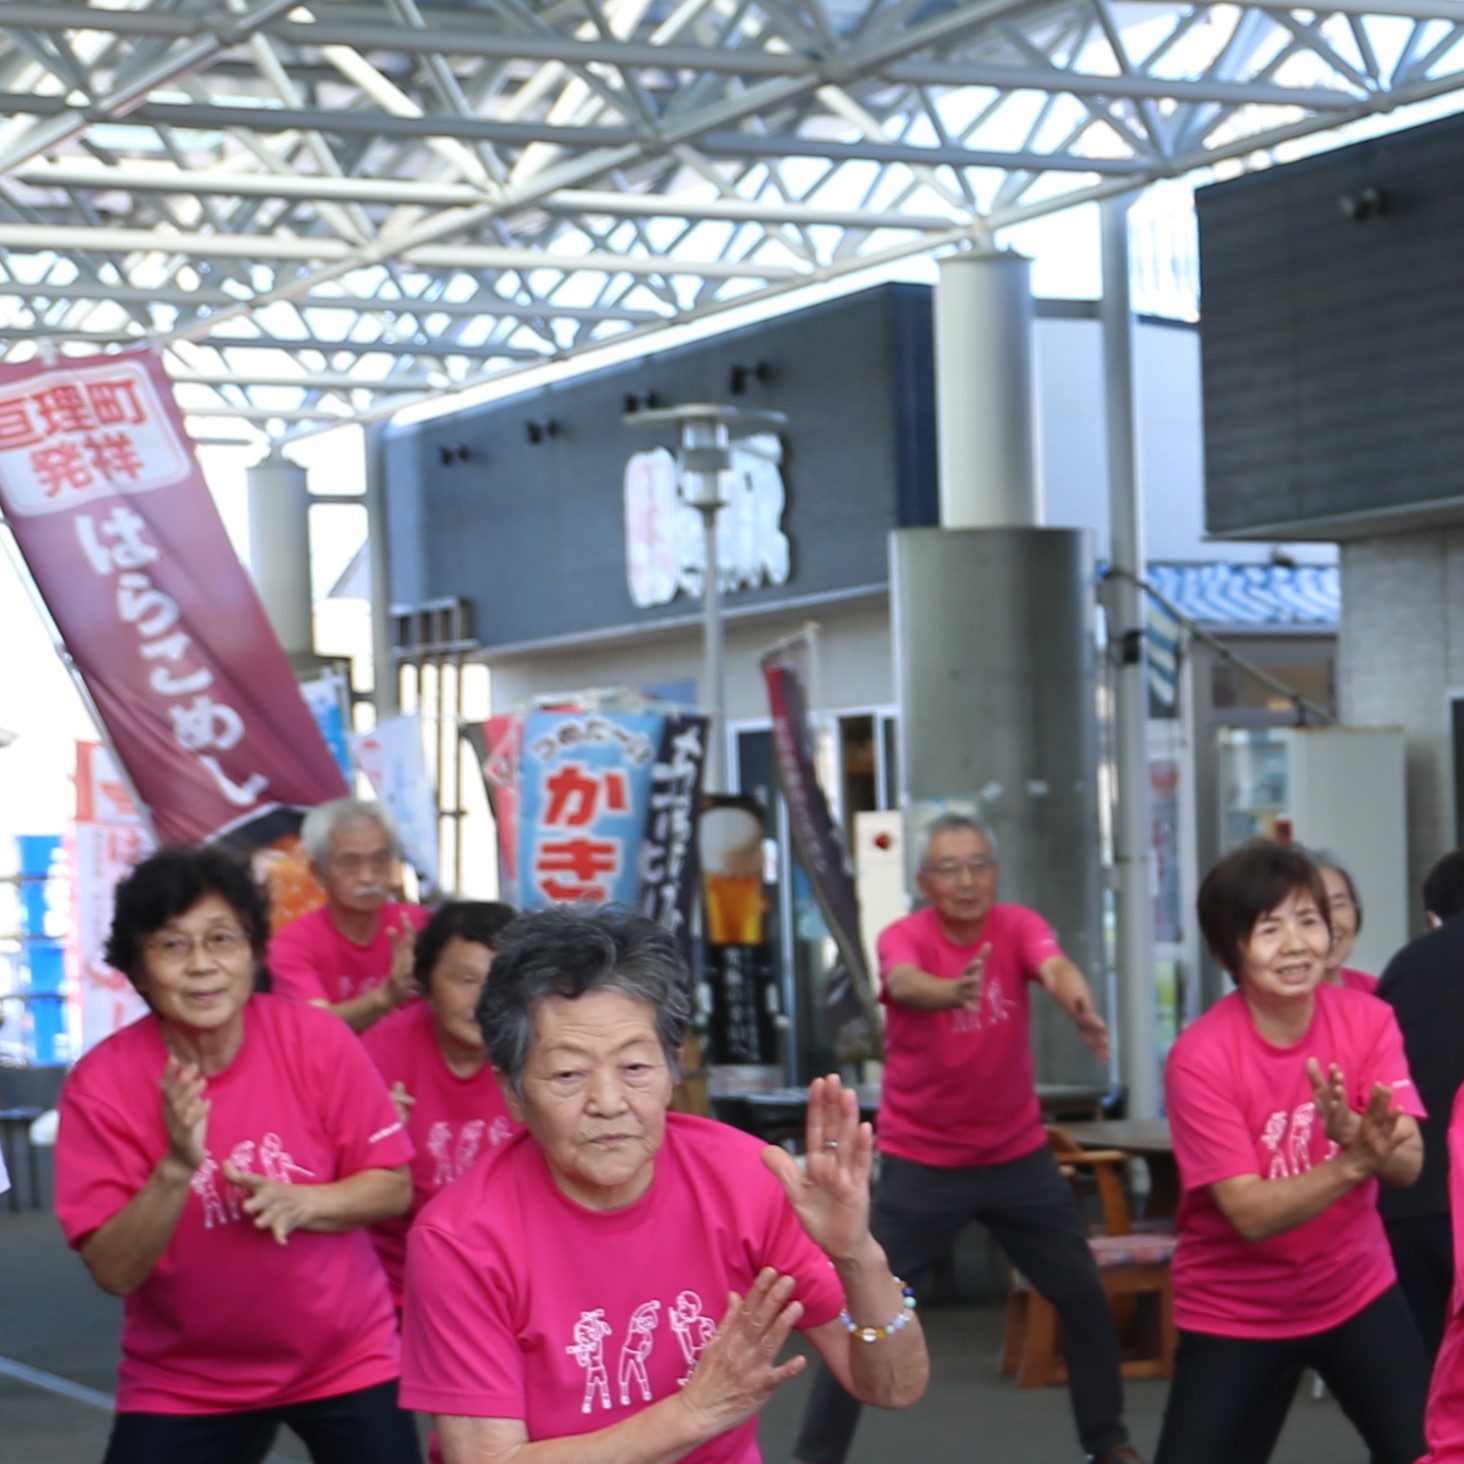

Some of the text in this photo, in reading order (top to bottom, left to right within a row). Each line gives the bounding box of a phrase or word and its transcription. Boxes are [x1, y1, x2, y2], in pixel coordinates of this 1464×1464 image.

[33, 433, 146, 497] 発祥
[77, 509, 267, 806] はらこめし
